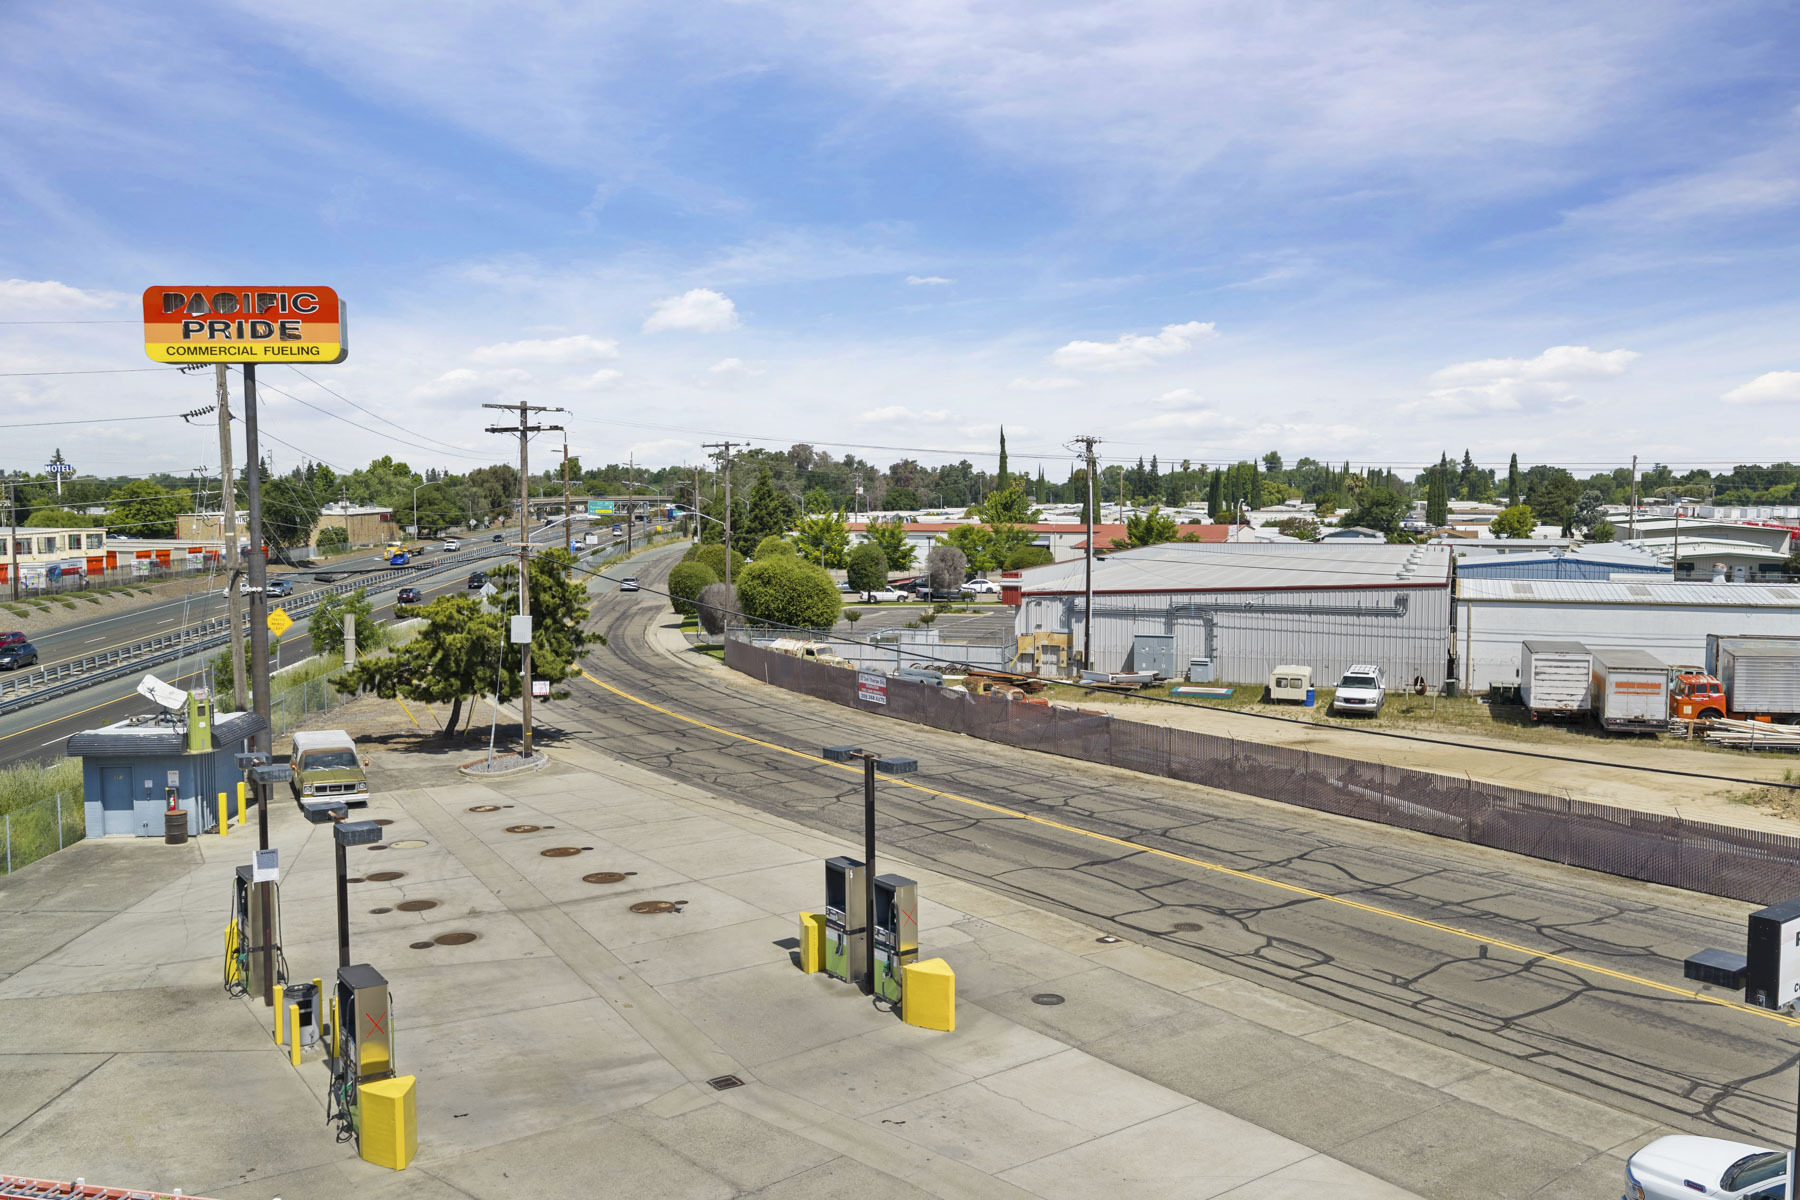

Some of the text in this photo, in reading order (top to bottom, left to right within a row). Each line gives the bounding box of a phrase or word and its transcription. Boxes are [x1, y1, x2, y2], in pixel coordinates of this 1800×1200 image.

[162, 292, 319, 315] PACIFIC
[182, 320, 302, 341] PRIDE
[166, 346, 320, 356] COMMERCIAL FUELING
[45, 464, 71, 473] MOTEL
